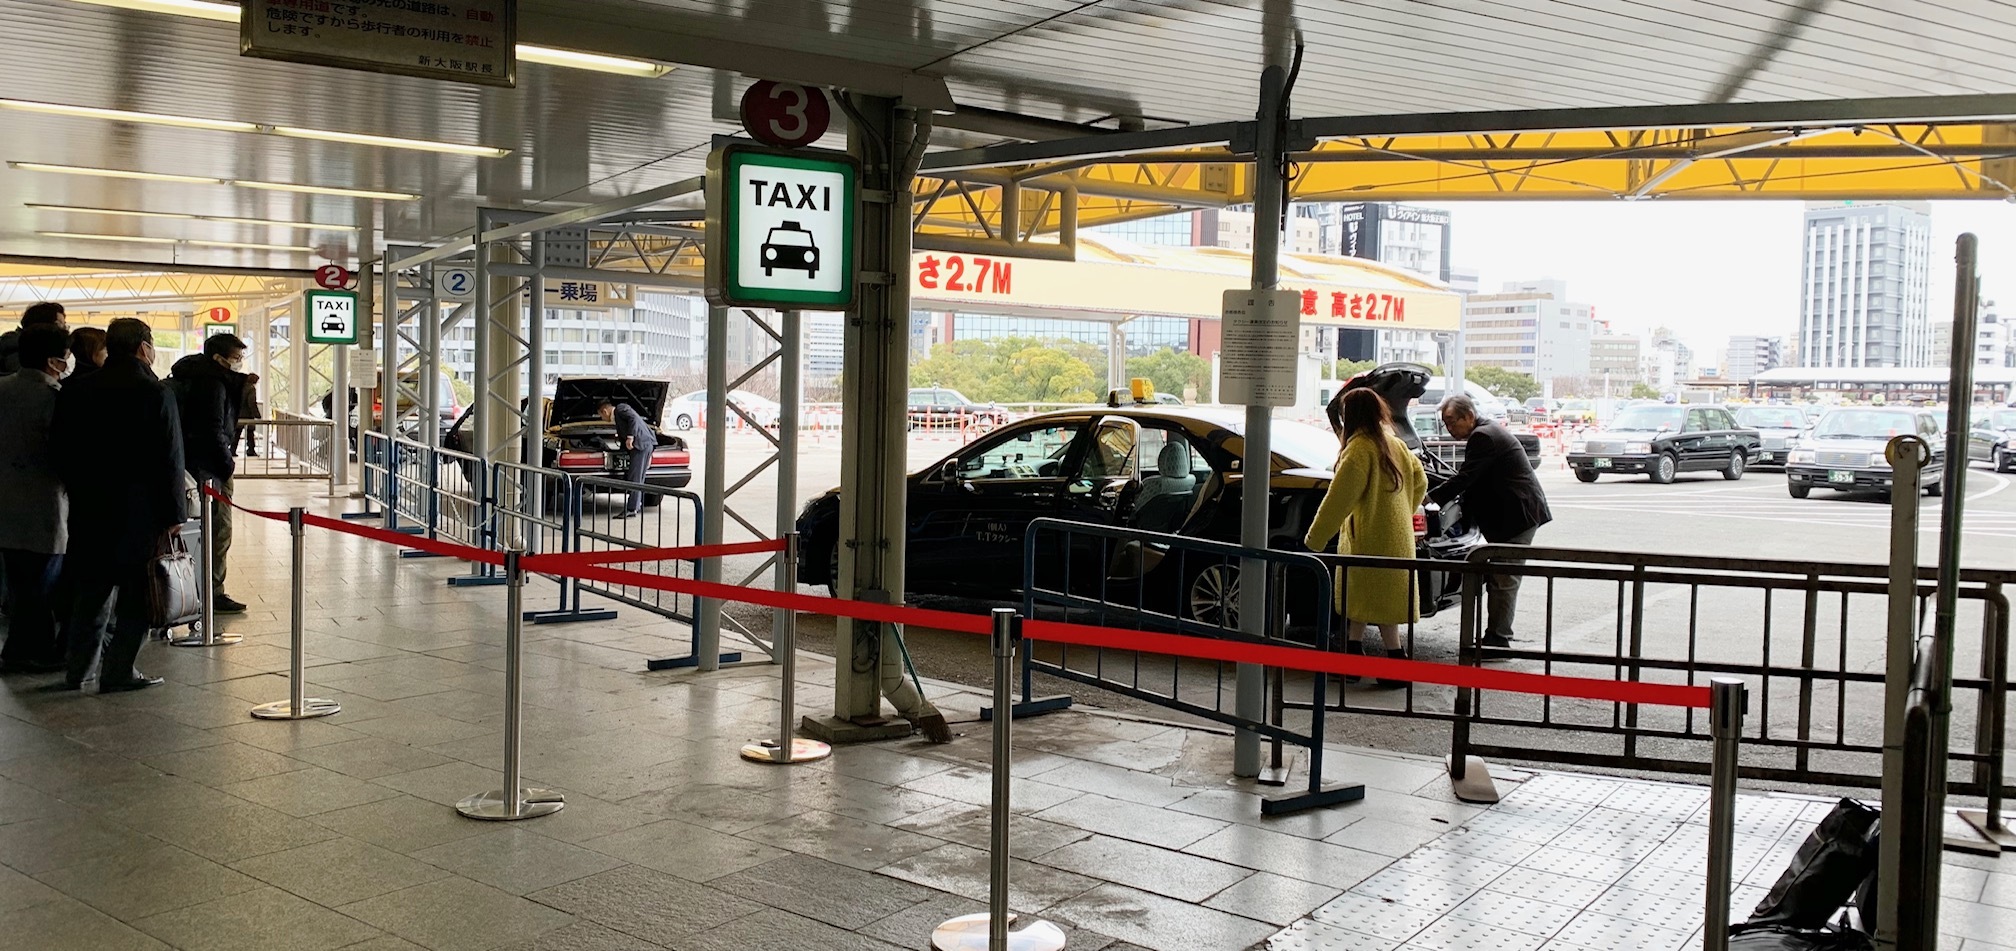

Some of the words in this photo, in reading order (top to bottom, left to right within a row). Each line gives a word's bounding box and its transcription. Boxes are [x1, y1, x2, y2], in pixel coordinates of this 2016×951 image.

[266, 7, 494, 49] 危険ですから歩行者の利用を禁止
[269, 21, 320, 39] します。
[769, 82, 808, 140] 3
[749, 179, 830, 212] TAXI
[1343, 211, 1365, 222] HOTEL
[324, 266, 341, 287] 2
[918, 254, 1012, 294] さ2.7M
[216, 308, 223, 321] 1
[316, 300, 350, 311] TAXI
[1331, 291, 1405, 322] 高さ2.7M
